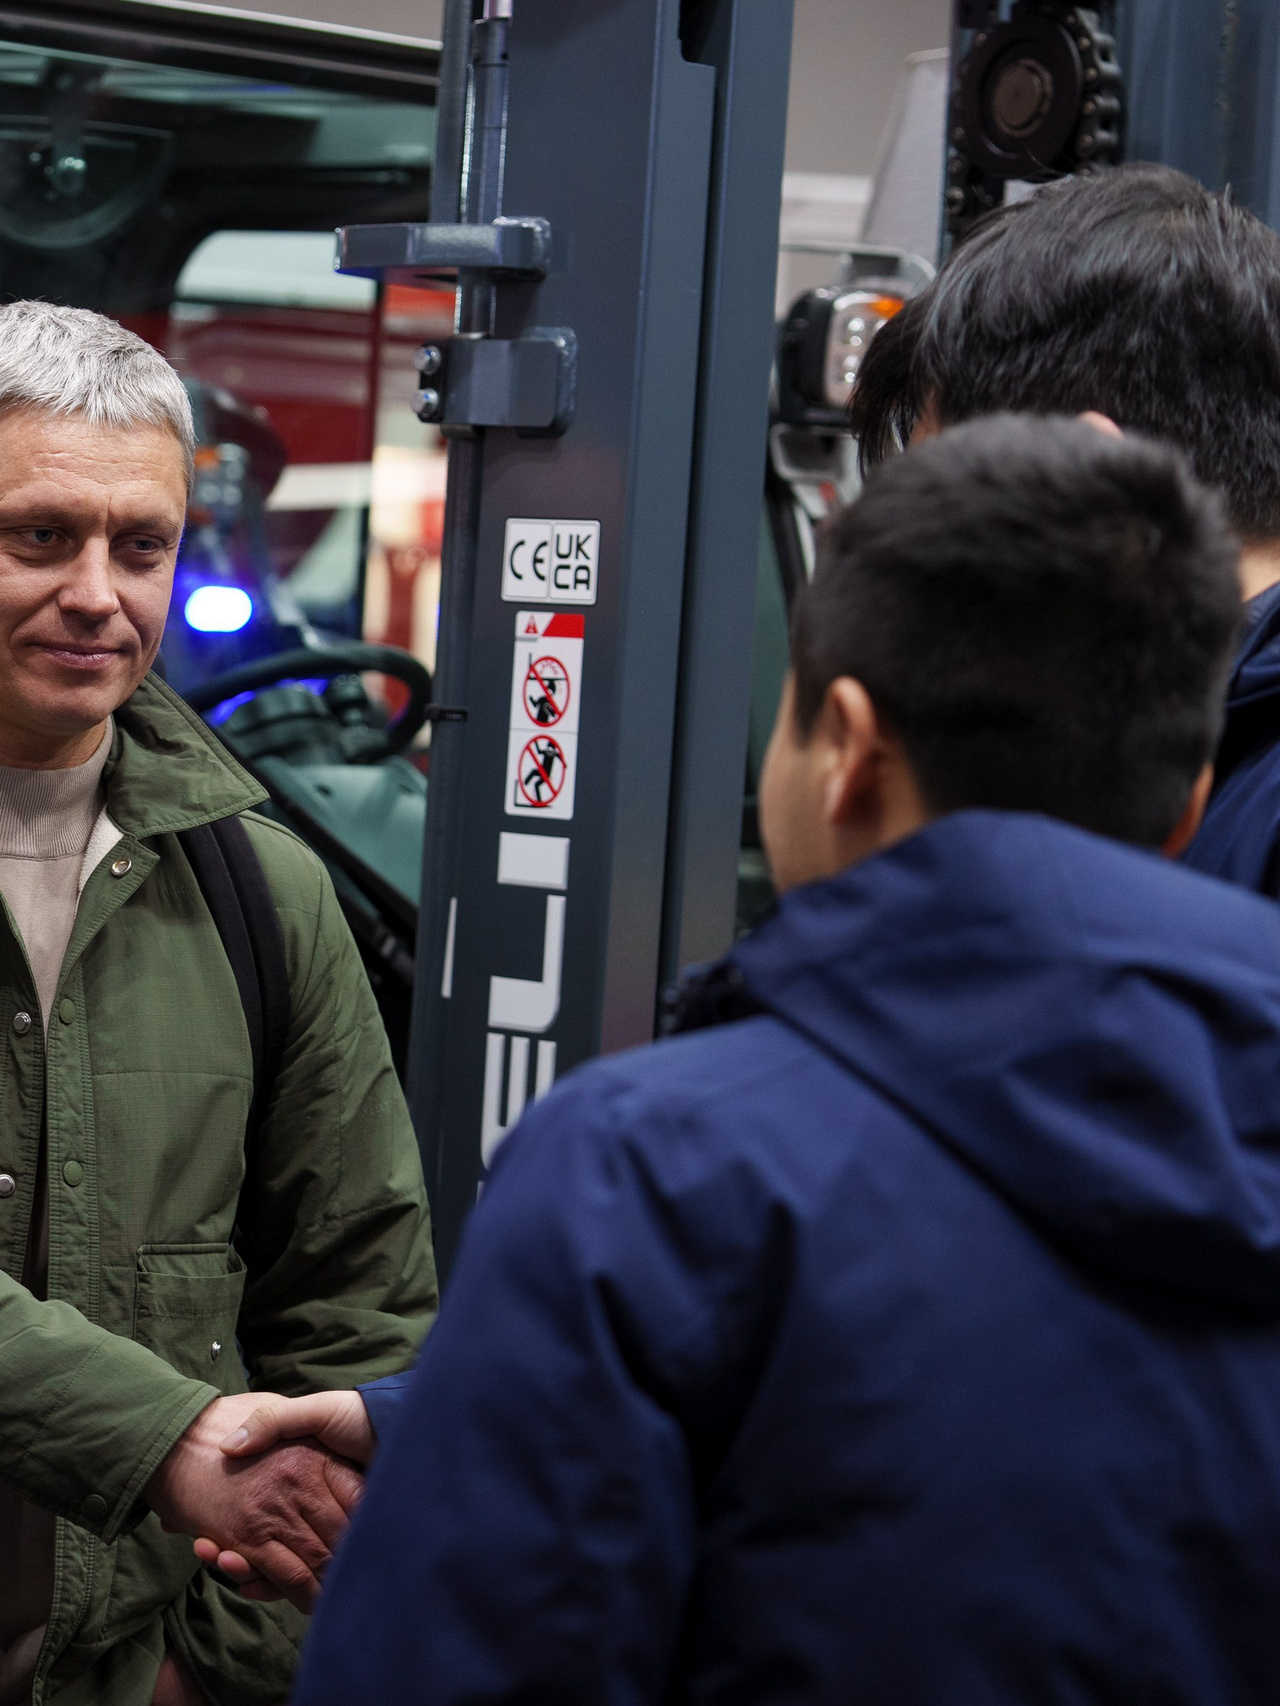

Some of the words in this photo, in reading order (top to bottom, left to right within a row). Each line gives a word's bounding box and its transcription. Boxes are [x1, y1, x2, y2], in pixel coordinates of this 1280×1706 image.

[510, 540, 548, 581] CE
[556, 534, 591, 560] UK
[554, 564, 590, 590] CA
[477, 831, 570, 1206] ELI
